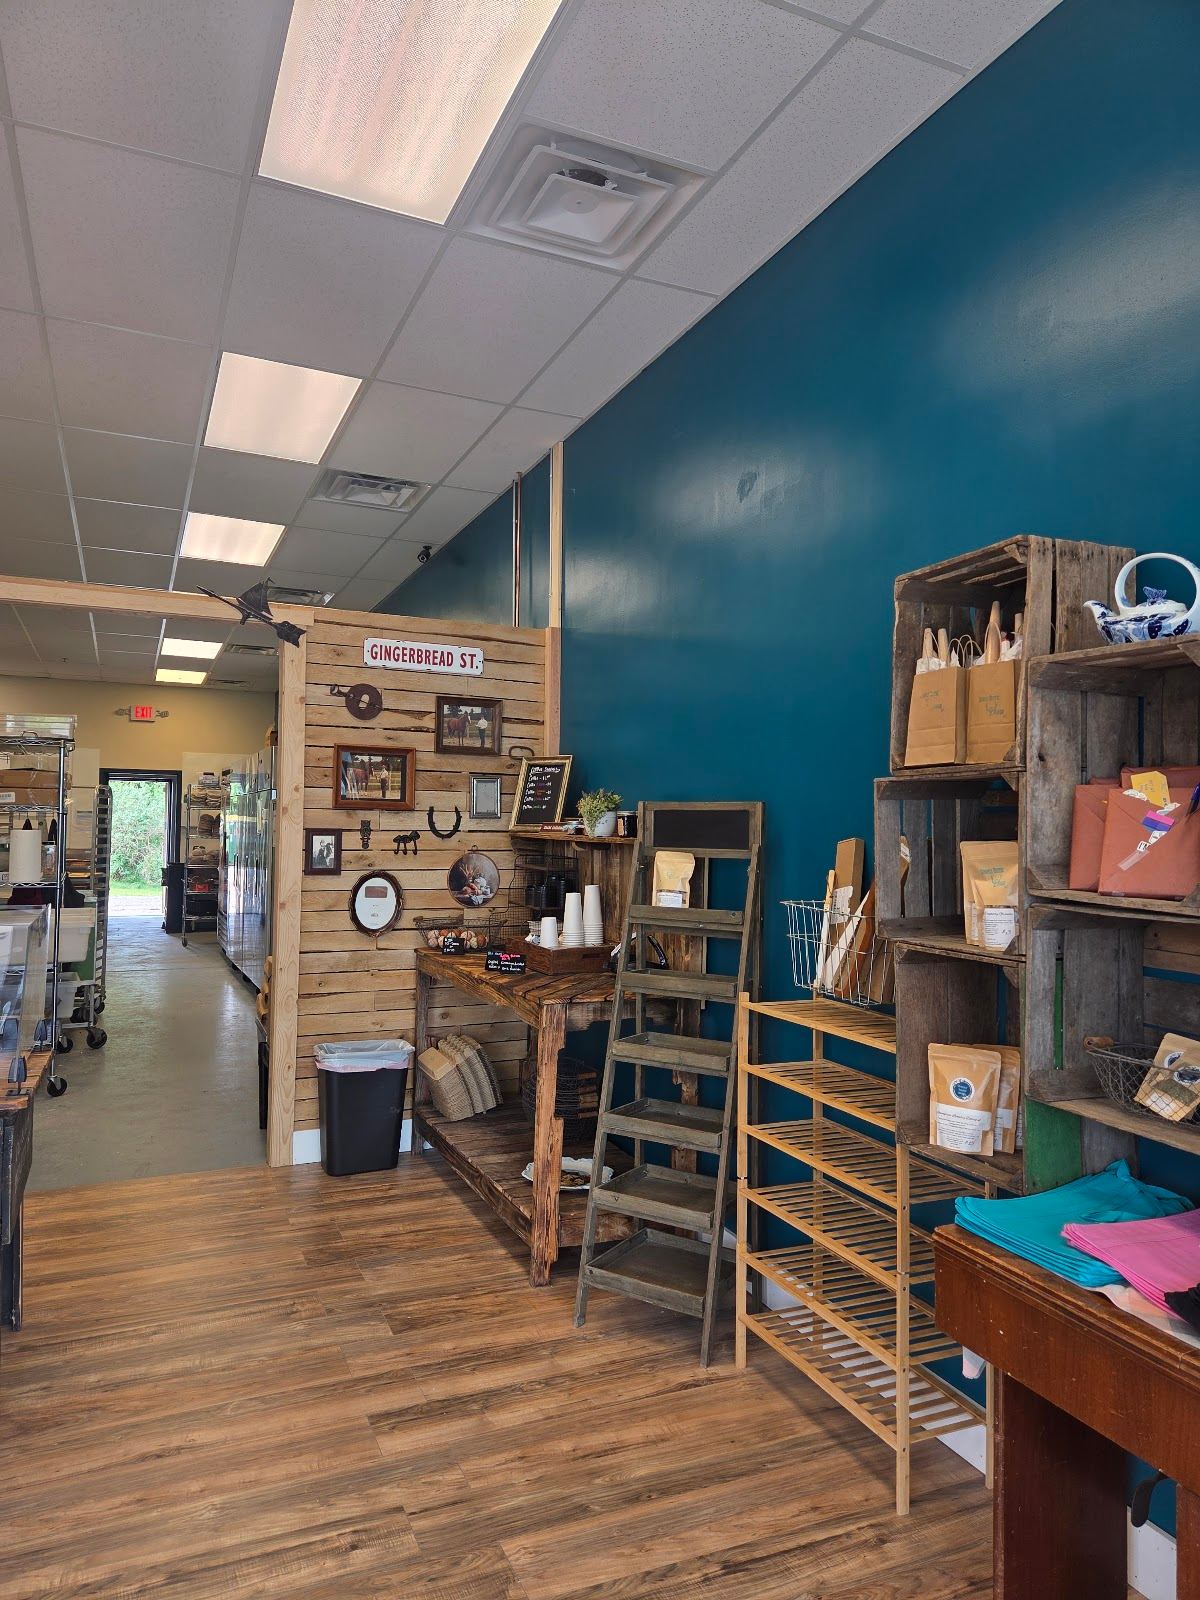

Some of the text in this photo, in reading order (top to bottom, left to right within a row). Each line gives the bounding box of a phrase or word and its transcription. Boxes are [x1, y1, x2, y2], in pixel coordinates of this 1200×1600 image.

[370, 643, 479, 670] GINGERBREAD ST.
[135, 706, 153, 719] EXIT
